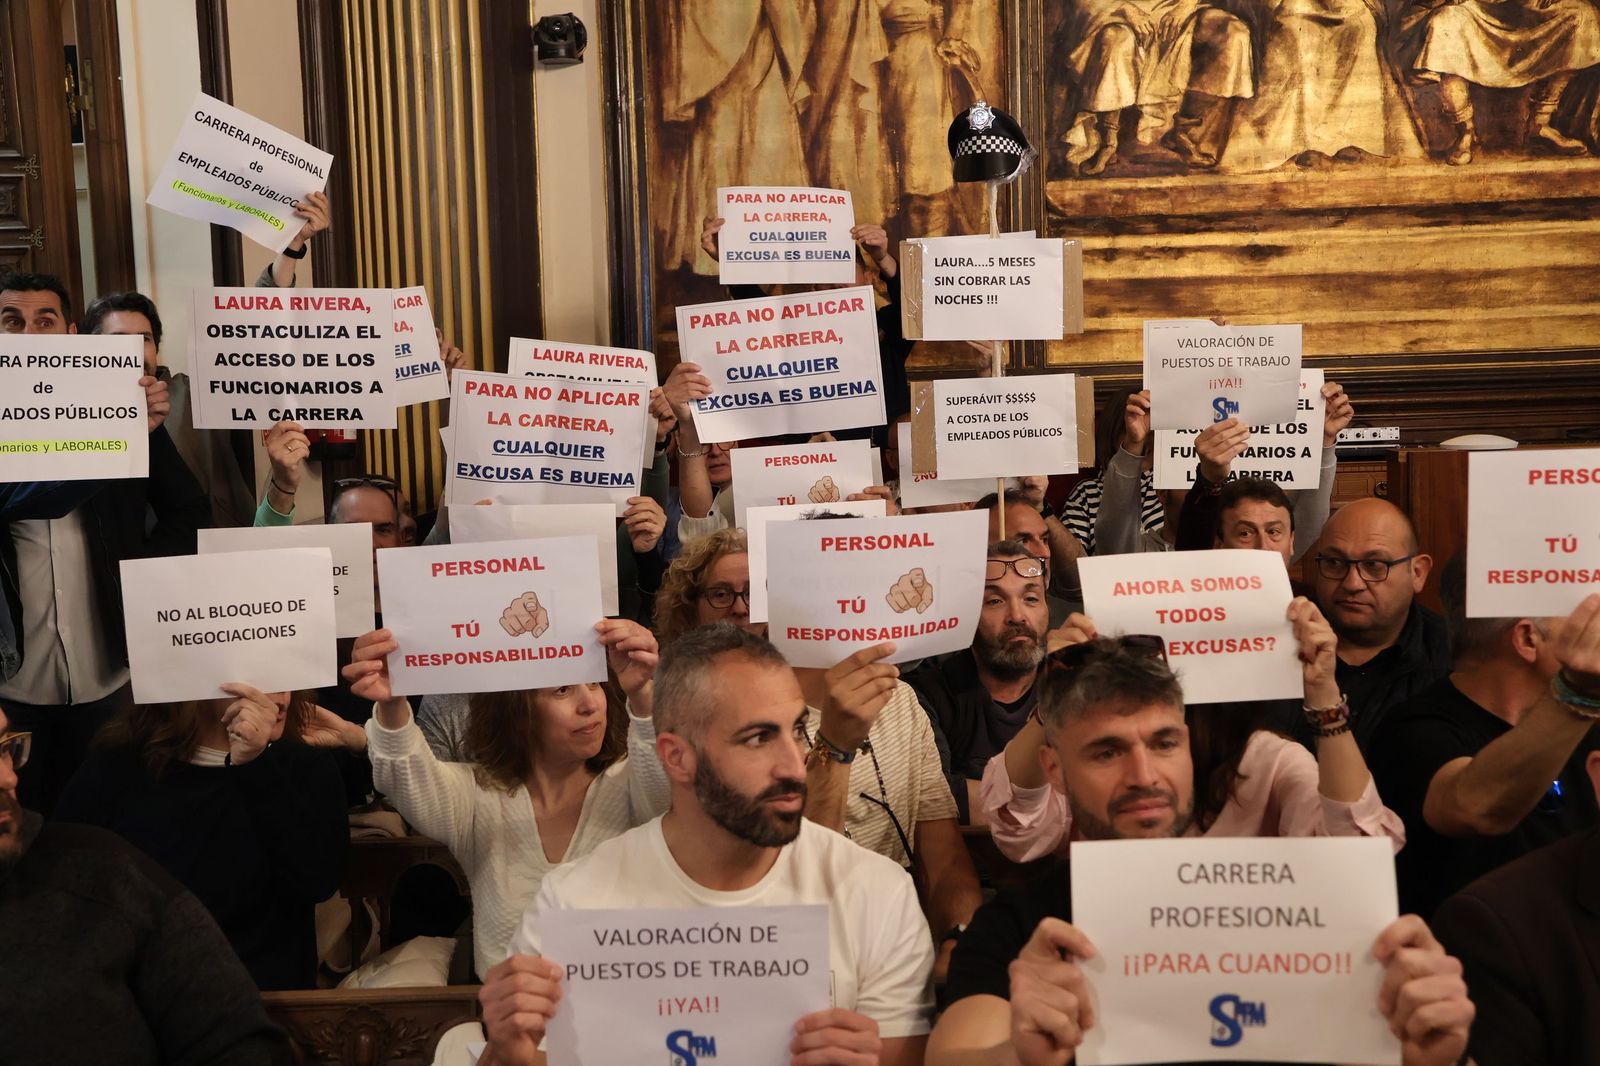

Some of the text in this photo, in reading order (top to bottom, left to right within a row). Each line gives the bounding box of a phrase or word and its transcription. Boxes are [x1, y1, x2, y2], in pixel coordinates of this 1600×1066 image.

[195, 111, 326, 179] CARRERA PROFESIONAL
[250, 161, 263, 172] de
[176, 152, 302, 210] EMPLEADOS PÚBLICO
[727, 194, 845, 204] PARA NO APLICAR
[744, 213, 831, 223] LA CARRERA,
[750, 232, 827, 243] CUALQUIER
[727, 251, 851, 262] EXCUSA ES BUENA
[999, 257, 1035, 266] MESES
[935, 276, 1030, 285] SIN COBRAR LAS
[215, 296, 370, 313] LAURA RIVERA,
[935, 295, 997, 304] NOCHES !!!
[690, 298, 864, 329] PARA NO APLICAR
[207, 324, 381, 338] OBSTACULIZA EL
[716, 329, 843, 354] LA CARRERA,
[1177, 335, 1274, 348] VALORACIÓN DE
[27, 356, 141, 368] PROFESIONAL
[215, 353, 374, 367] ACCESO DE LOS
[534, 348, 647, 371] LAURA RIVERA,
[1162, 356, 1290, 368] PUESTOS DE TRABAJO
[727, 357, 839, 384] CUALQUIER
[34, 382, 53, 393] de
[210, 381, 383, 394] FUNCIONARIOS A
[1210, 378, 1241, 389] ¡¡YA!!
[466, 381, 639, 405] PARA NO APLICAR
[695, 380, 877, 412] EXCUSA ES BUENA
[946, 395, 1002, 405] SUPERÁVIT
[56, 404, 137, 419] PÚBLICOS
[232, 408, 363, 421] LA CARRERA
[947, 412, 1028, 424] A COSTA DE LOS
[488, 411, 613, 435] LA CARRERA,
[1276, 423, 1307, 434] LOS
[948, 428, 1062, 441] EMPLEADOS PÚBLICOS
[43, 445, 50, 454] y
[492, 440, 604, 461] CUALQUIER
[1301, 447, 1311, 458] A
[765, 453, 837, 467] PERSONAL
[456, 463, 634, 488] EXCUSA ES BUENA
[777, 494, 797, 506] TÚ
[822, 533, 934, 551] PERSONAL
[1545, 533, 1579, 553] TÚ
[333, 566, 348, 576] DE
[432, 557, 544, 577] PERSONAL
[1113, 576, 1262, 596] AHORA SOMOS
[158, 600, 306, 622] NO AL BLOQUEO DE
[837, 595, 866, 614] TÚ
[1156, 607, 1226, 624] TODOS
[172, 625, 296, 646] NEGOCIACIONES
[451, 619, 481, 639] TÚ
[787, 617, 958, 641] RESPONSABILIDAD
[1169, 637, 1275, 655] EXCUSAS?
[405, 645, 583, 667] RESPONSABILIDAD
[1178, 863, 1295, 884] CARRERA
[1151, 907, 1325, 928] PROFESIONAL
[594, 923, 776, 946] VALORACIÓN DE
[567, 959, 808, 981] PUESTOS DE TRABAJO
[1125, 953, 1351, 976] ¡¡PARA CUANDO!!
[659, 997, 718, 1016] ¡¡YA!!
